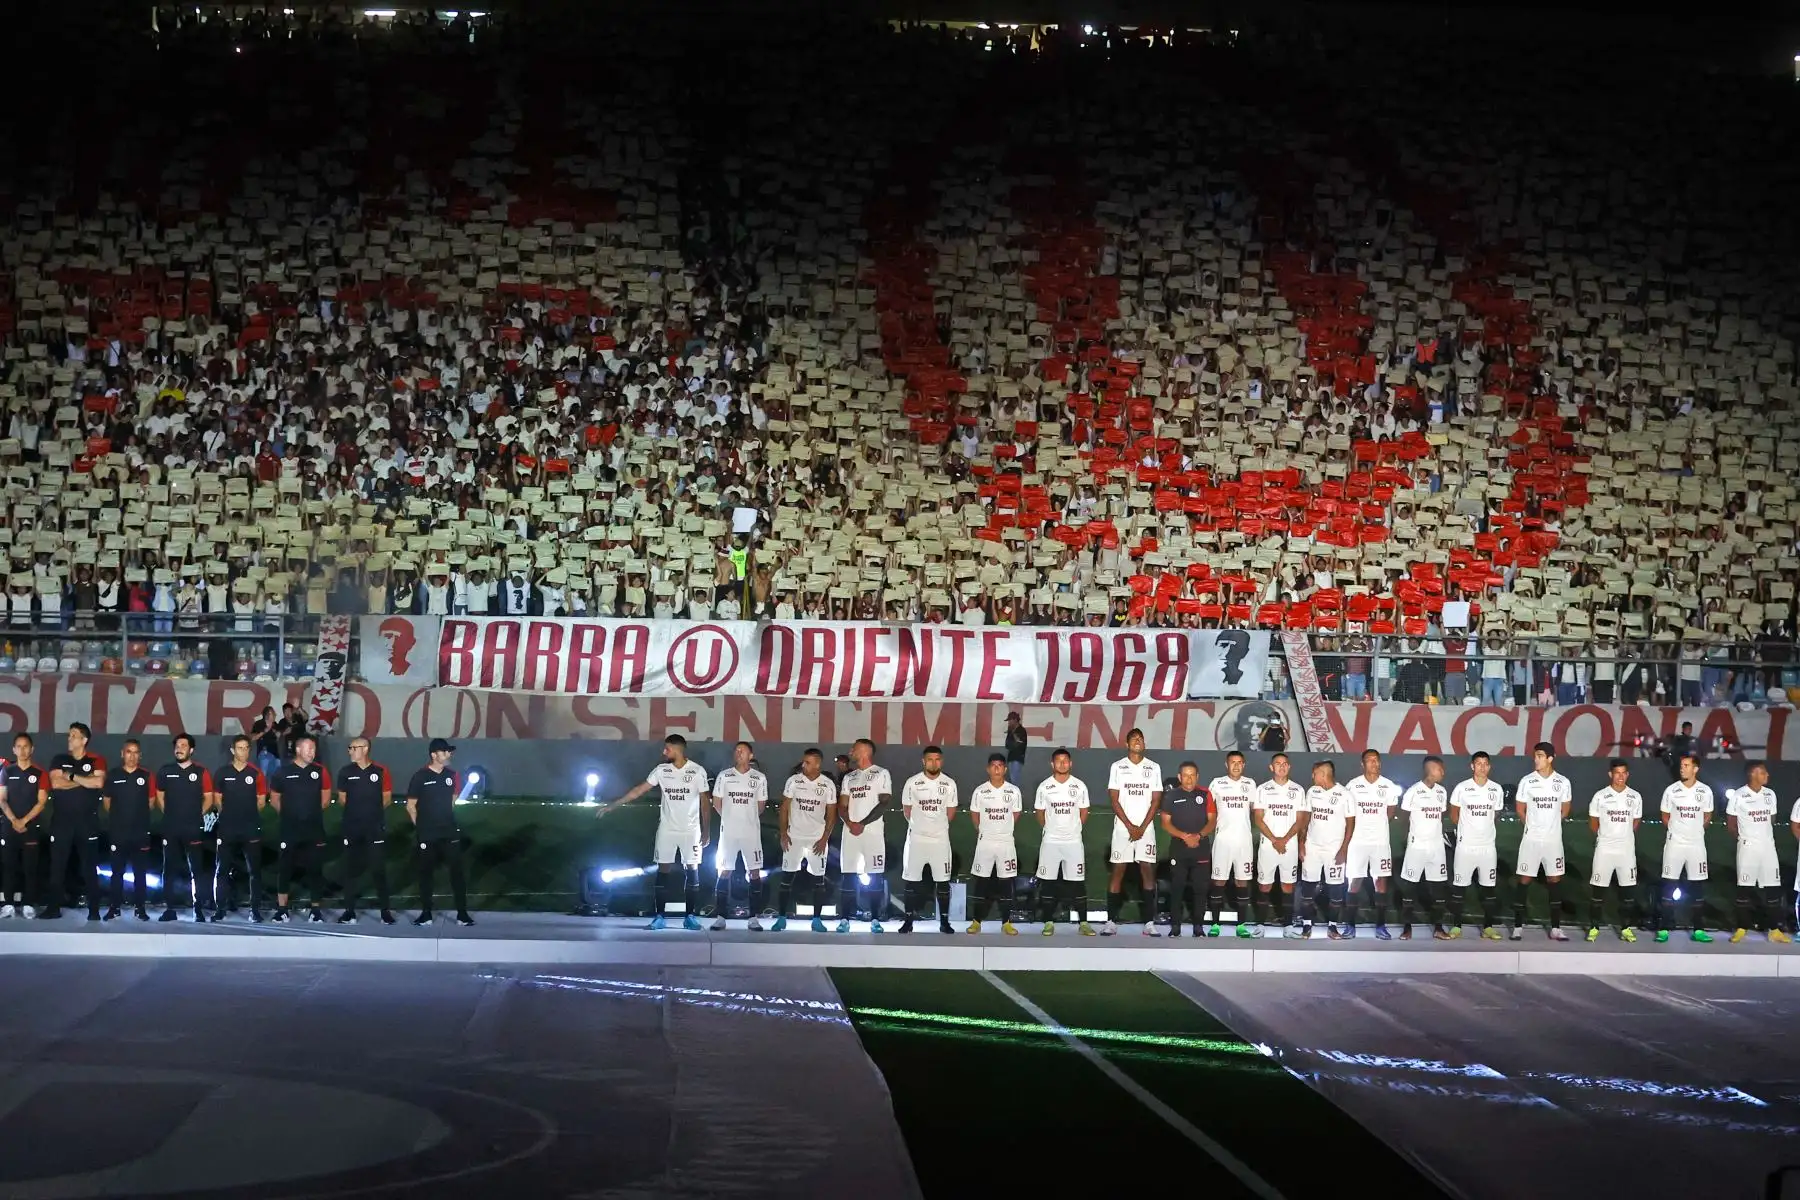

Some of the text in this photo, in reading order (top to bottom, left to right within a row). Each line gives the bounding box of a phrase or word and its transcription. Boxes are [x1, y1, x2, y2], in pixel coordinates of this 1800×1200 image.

[439, 619, 650, 693] BARRA
[754, 624, 1011, 700] ORIENTE
[1035, 631, 1189, 702] 1968
[872, 855, 883, 866] 15
[1005, 859, 1017, 871] 36
[1329, 867, 1342, 878] 27
